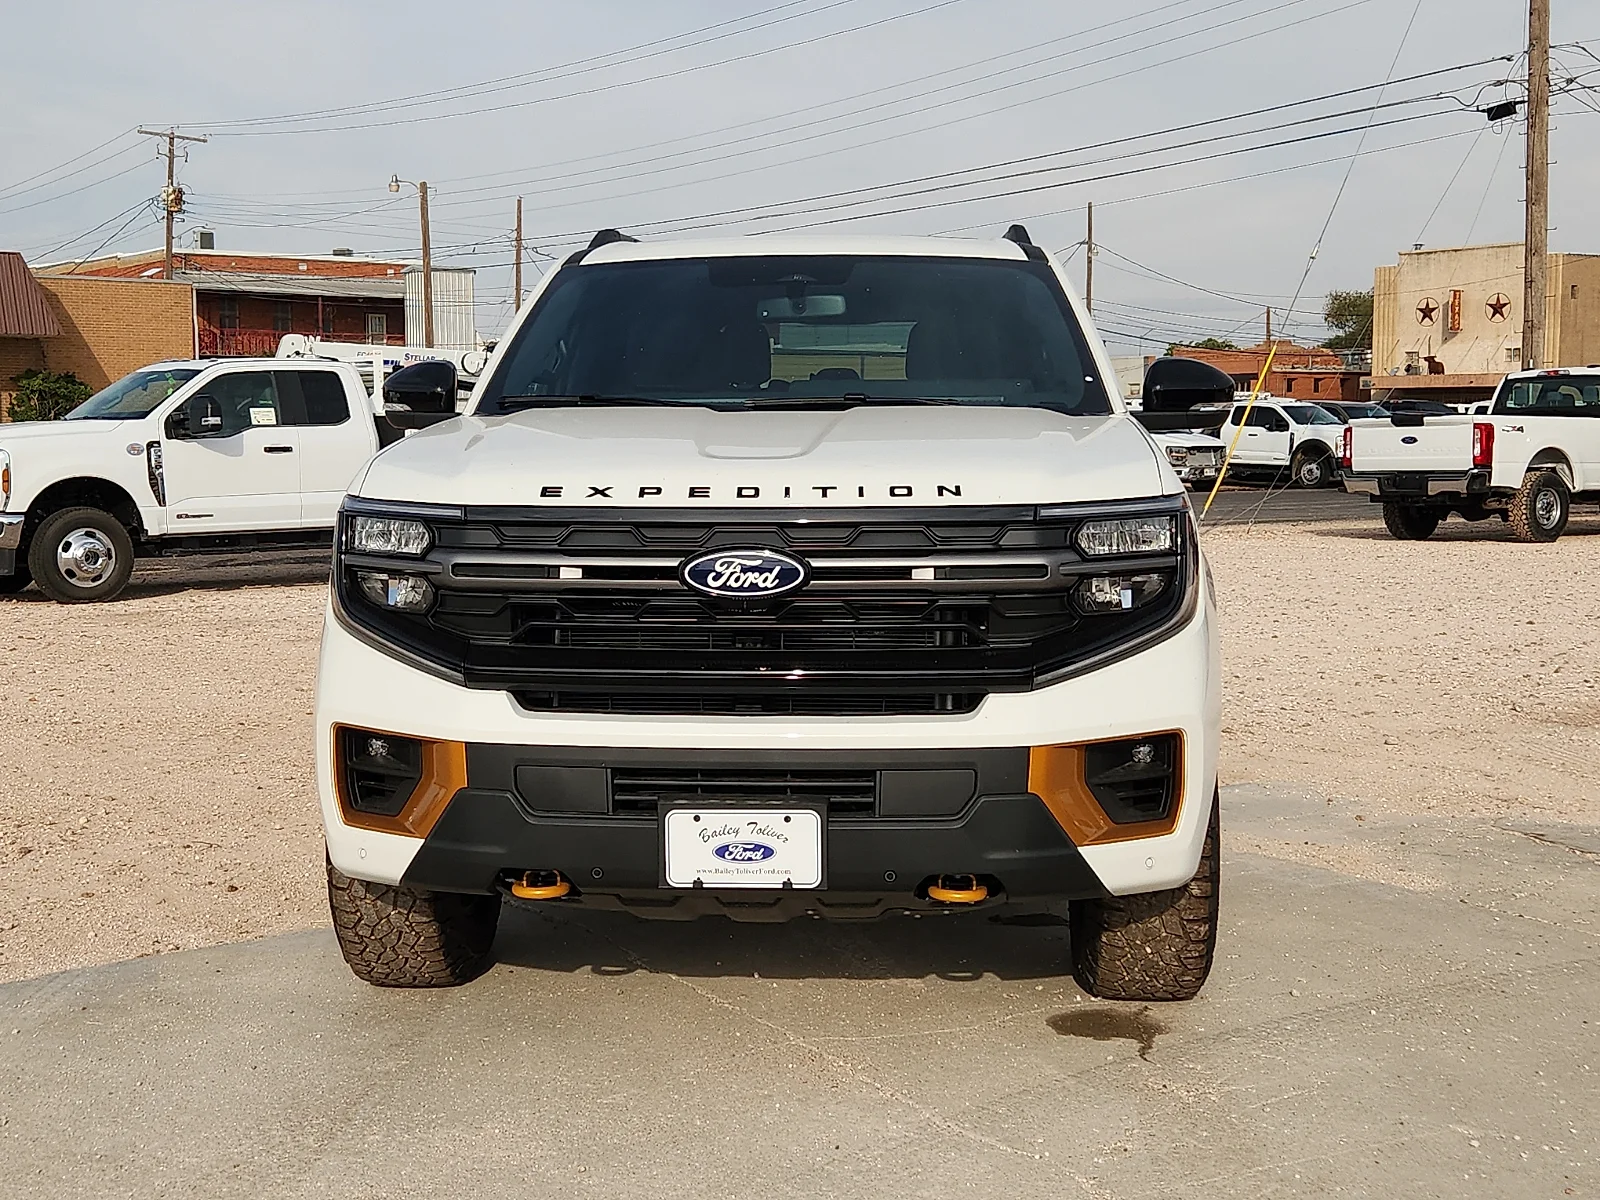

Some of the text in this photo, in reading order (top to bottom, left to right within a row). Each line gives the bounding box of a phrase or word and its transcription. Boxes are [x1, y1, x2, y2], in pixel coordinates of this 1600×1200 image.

[539, 485, 962, 498] EXPEDITION
[706, 557, 782, 588] Ford
[698, 821, 789, 844] Bailey Toliver
[724, 843, 764, 860] Ford
[696, 867, 792, 876] www.BaileyToliverFord.com
